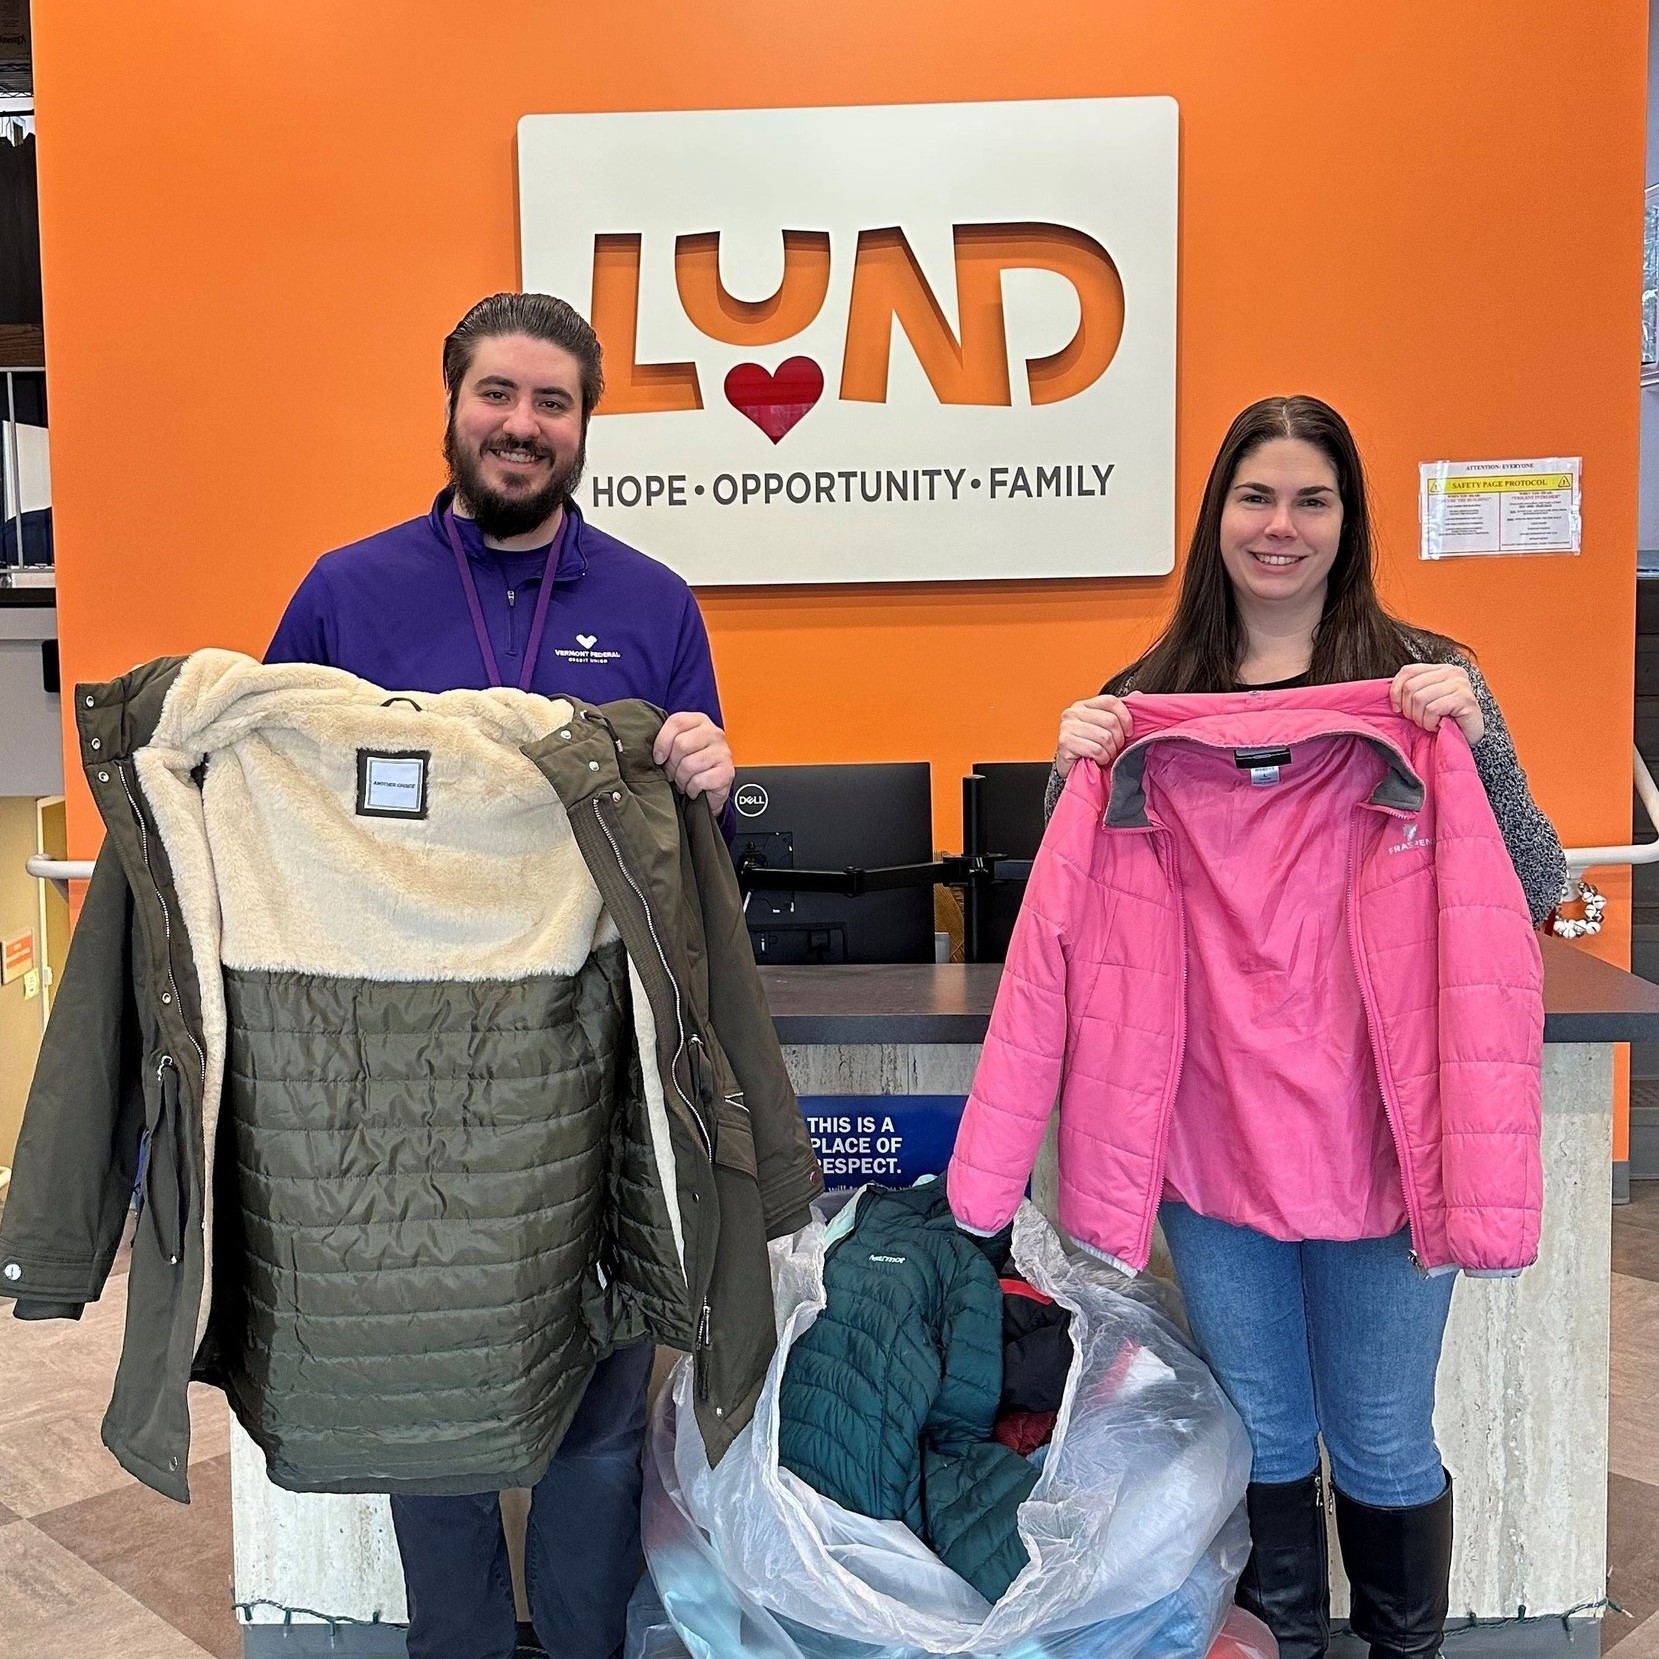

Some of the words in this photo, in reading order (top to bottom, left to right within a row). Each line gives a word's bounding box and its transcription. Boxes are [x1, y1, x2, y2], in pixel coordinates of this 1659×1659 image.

[590, 221, 1126, 417] LUND
[592, 475, 687, 507] HOPE
[713, 468, 967, 506] OPPORTUNITY
[990, 463, 1115, 499] FAMILY
[1482, 480, 1503, 488] PAGE
[1504, 479, 1548, 487] PROTOCOL
[554, 649, 590, 657] VERMONT
[739, 796, 765, 805] DELL
[807, 1116, 851, 1133] THIS
[857, 1116, 876, 1133] IS
[881, 1116, 895, 1133] A
[810, 1137, 871, 1154] PLACE
[876, 1137, 903, 1154] OF
